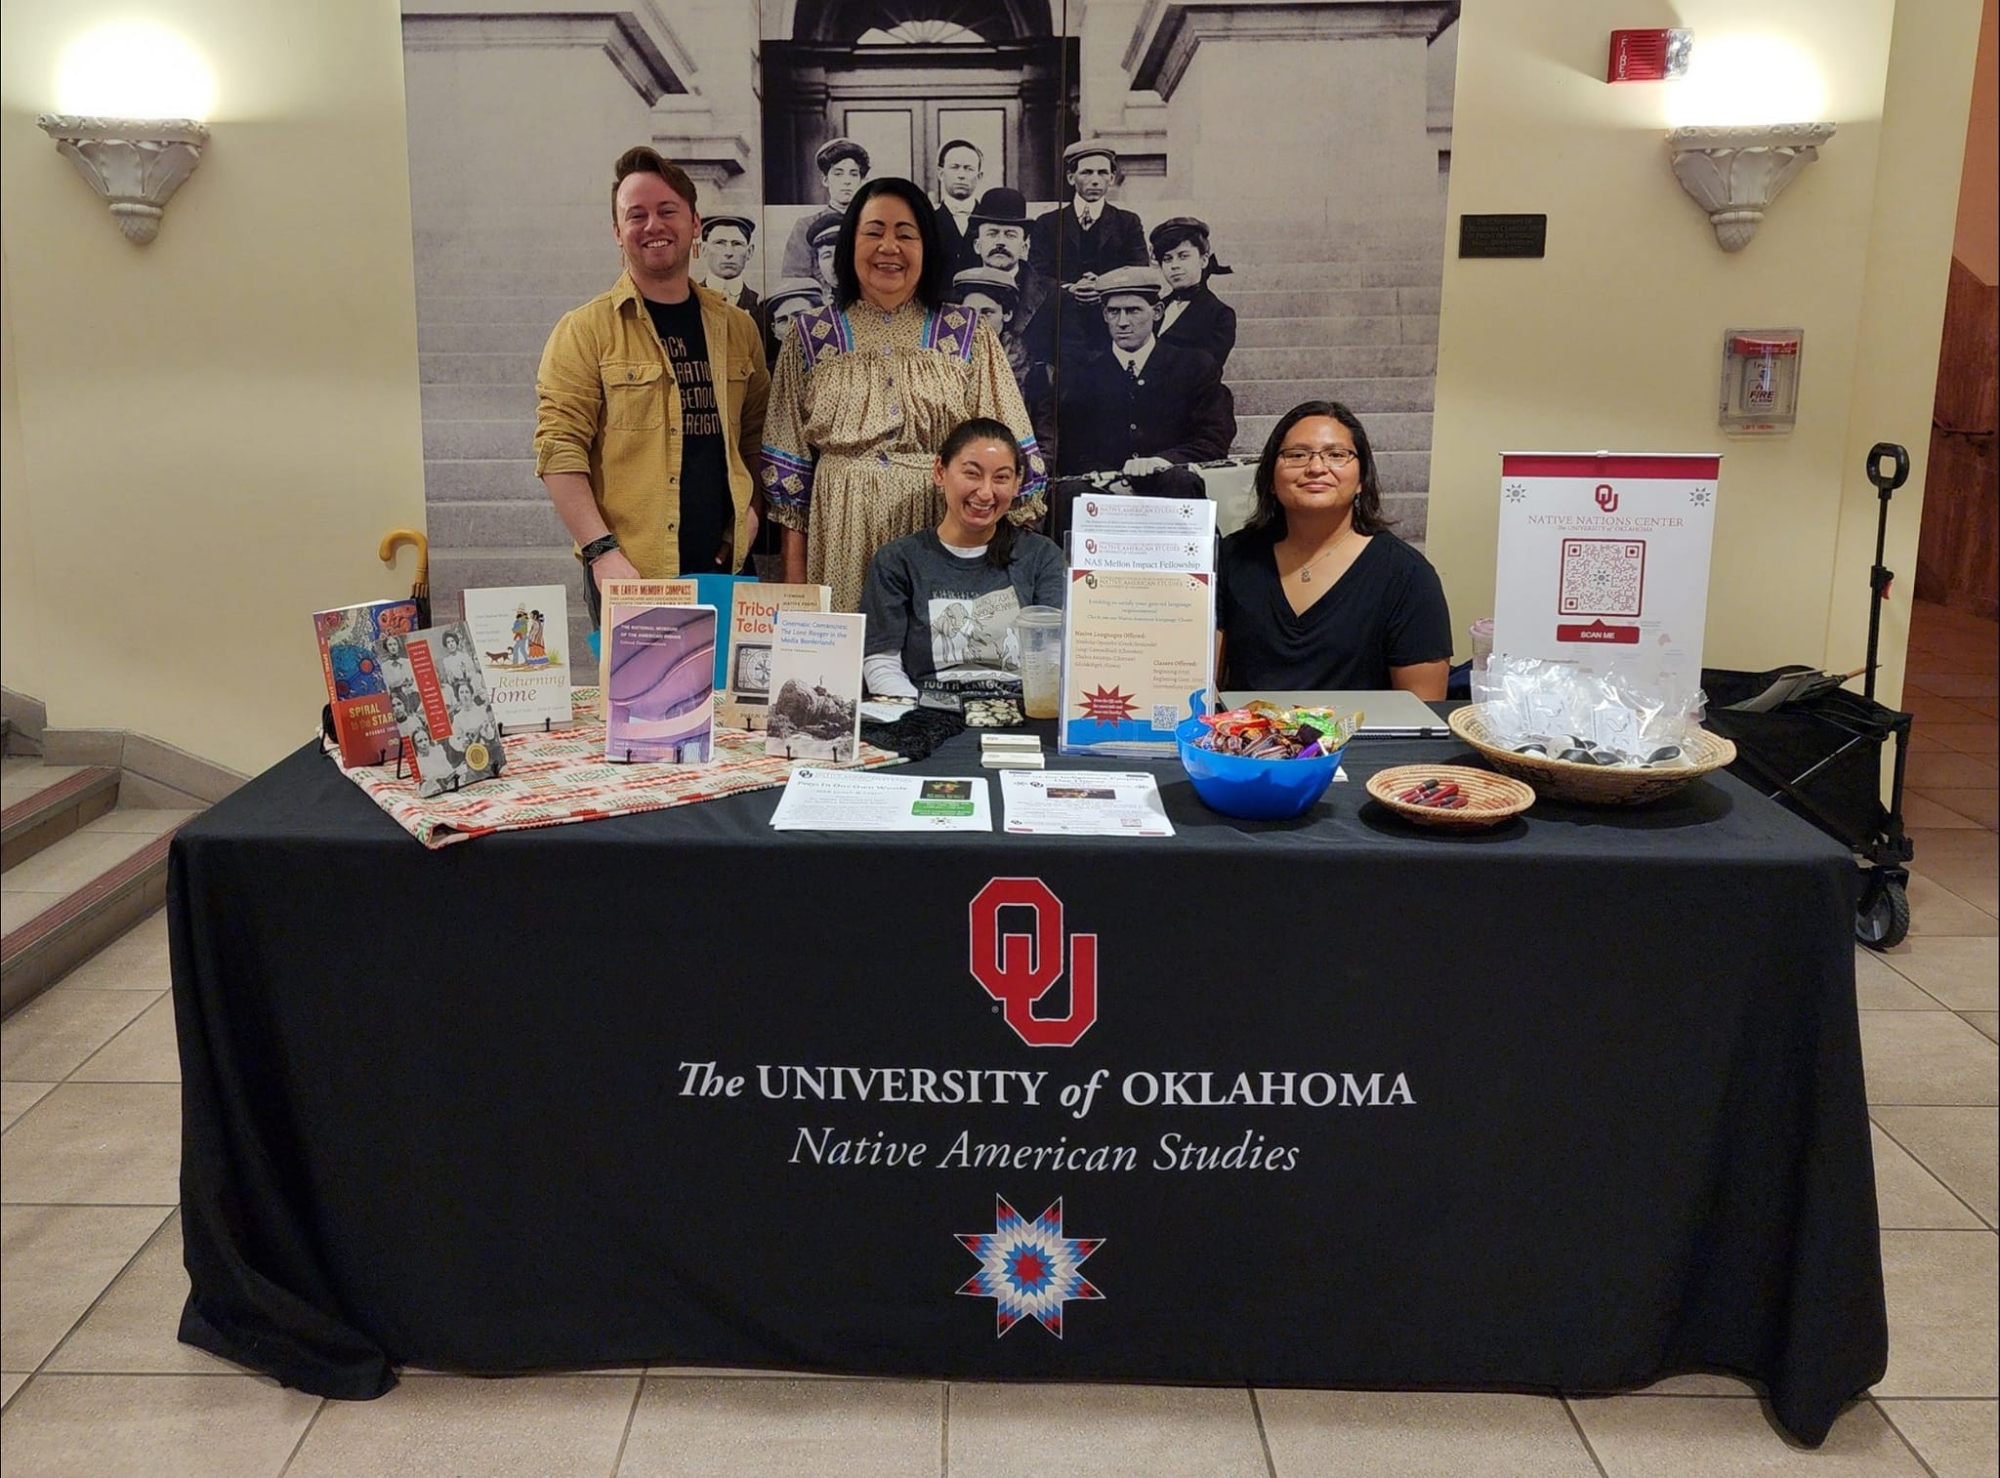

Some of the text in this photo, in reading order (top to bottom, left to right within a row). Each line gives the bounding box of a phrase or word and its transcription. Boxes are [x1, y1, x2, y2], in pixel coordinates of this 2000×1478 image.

[1750, 391, 1776, 399] FIRE
[1594, 484, 1619, 513] OU
[1086, 502, 1099, 517] OU
[1528, 515, 1684, 527] NATIVE NATIONS CENTER
[1085, 539, 1098, 554] OU
[1084, 558, 1103, 566] NAS
[1132, 560, 1158, 570] Impact
[1159, 559, 1201, 570] Fellowship
[1085, 574, 1098, 589] OU
[609, 585, 692, 596] THE EARTH MEMORY COMPASS
[738, 602, 779, 616] Tribal
[1580, 631, 1615, 639] SCAN ME
[499, 674, 565, 688] Returning
[349, 702, 381, 719] SPIRAL
[969, 877, 1098, 1047] OU
[678, 1061, 1416, 1118] The UNIVERSITY of OKLAHOMA
[788, 1128, 1300, 1172] Native American Studies
